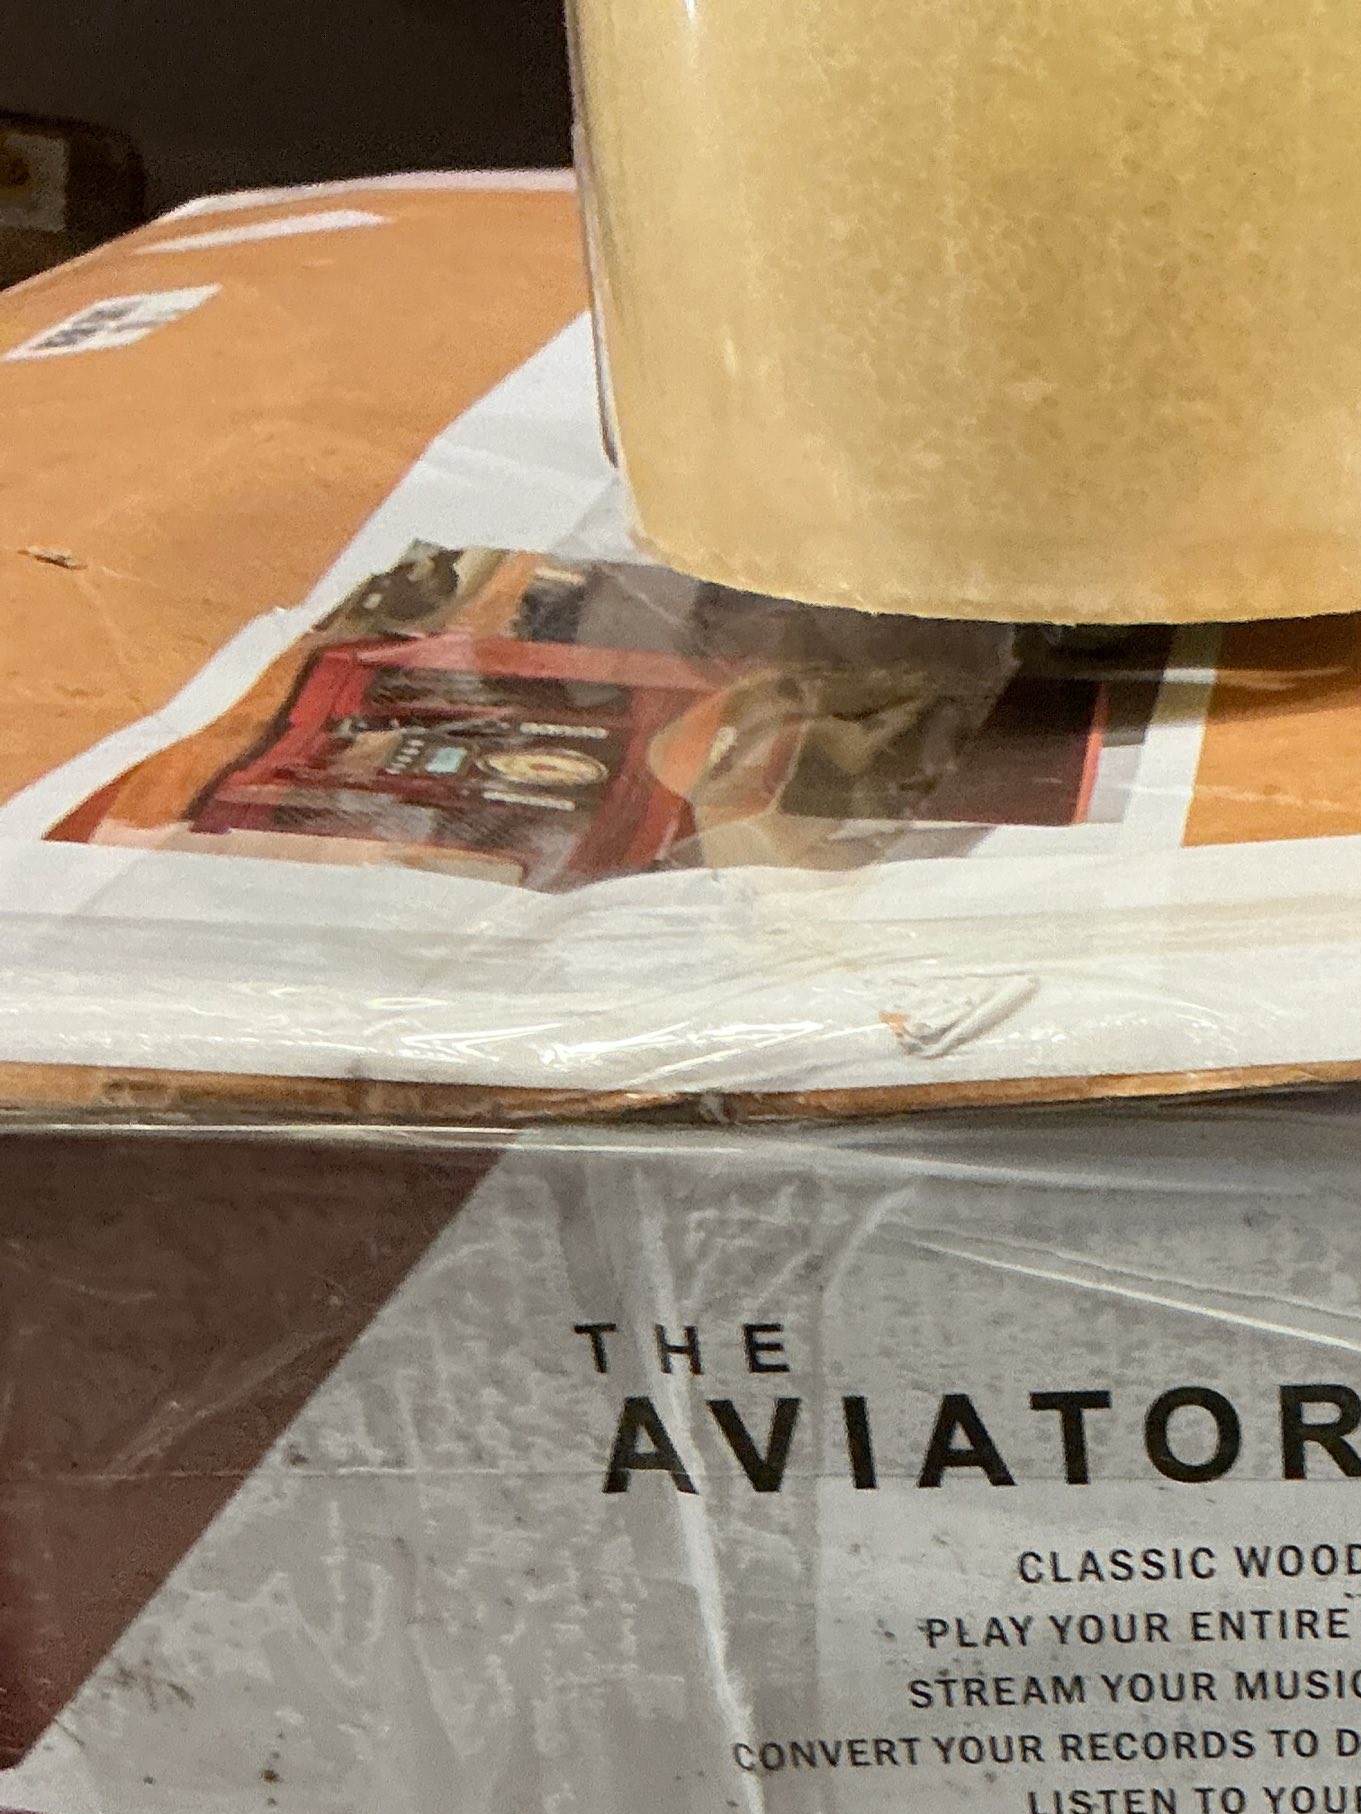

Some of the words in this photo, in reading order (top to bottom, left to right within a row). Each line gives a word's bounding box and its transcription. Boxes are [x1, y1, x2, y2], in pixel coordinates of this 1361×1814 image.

[575, 1323, 791, 1374] THE
[1017, 1548, 1217, 1584] CLASSIC
[926, 1615, 1034, 1648] PLAY
[1049, 1614, 1171, 1645] YOUR
[1191, 1608, 1350, 1641] ENTIRE
[908, 1673, 1087, 1709] STREAM
[1101, 1671, 1217, 1702] YOUR
[732, 1736, 920, 1772] CONVERT
[932, 1734, 1045, 1765] YOUR
[1060, 1729, 1257, 1763] RECORDS
[1270, 1728, 1319, 1758] TO
